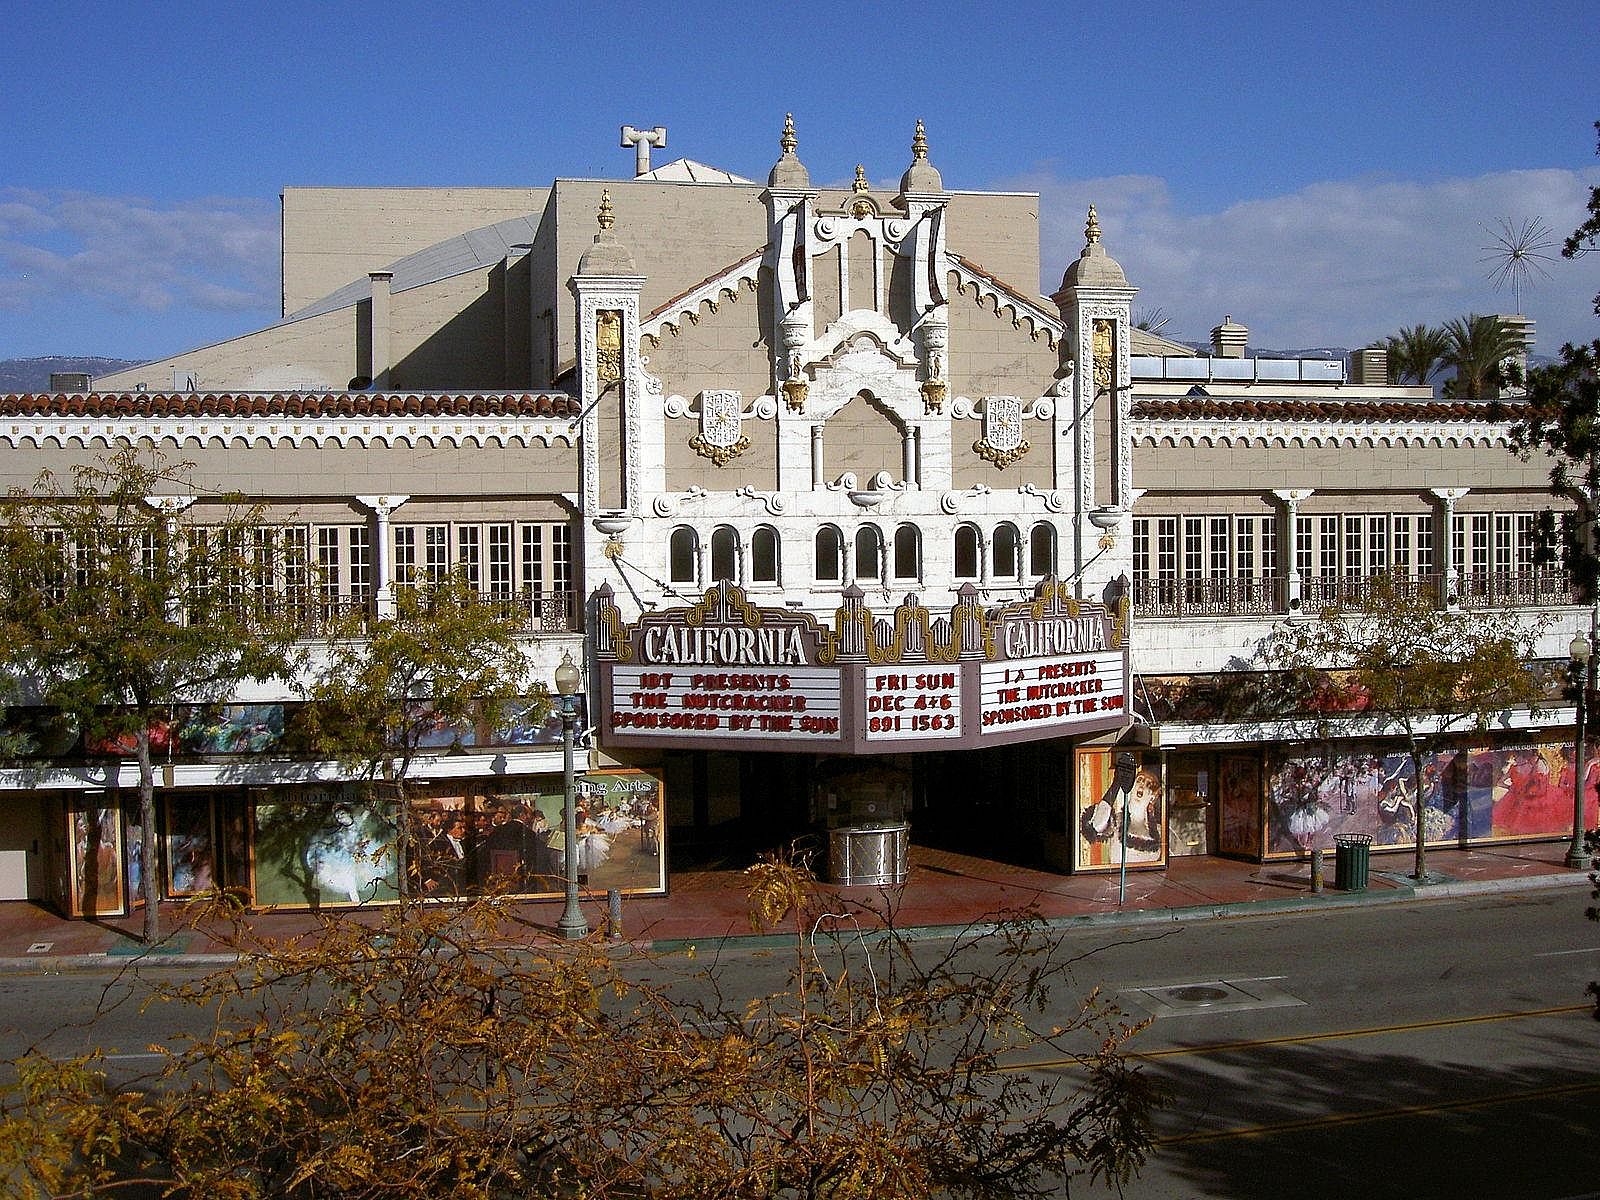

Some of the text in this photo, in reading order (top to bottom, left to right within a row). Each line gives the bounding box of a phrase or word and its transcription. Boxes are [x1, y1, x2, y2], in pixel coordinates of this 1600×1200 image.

[645, 624, 808, 664] CALIFORNIA
[1005, 615, 1106, 658] CALIFORNIA
[1038, 660, 1097, 681] PRESENTS
[691, 674, 791, 691] PRESENTS
[875, 673, 955, 691] FRI SUN
[997, 679, 1103, 704] THE NUTCRACKER
[631, 692, 806, 712] THE NUTCRACKER
[869, 695, 906, 712] DEC
[982, 695, 1123, 726] SPONSORED BY THE SUN
[610, 711, 839, 734] SPONSORED BY THE SUN
[869, 714, 955, 732] 891 1563
[611, 780, 652, 793] Arts
